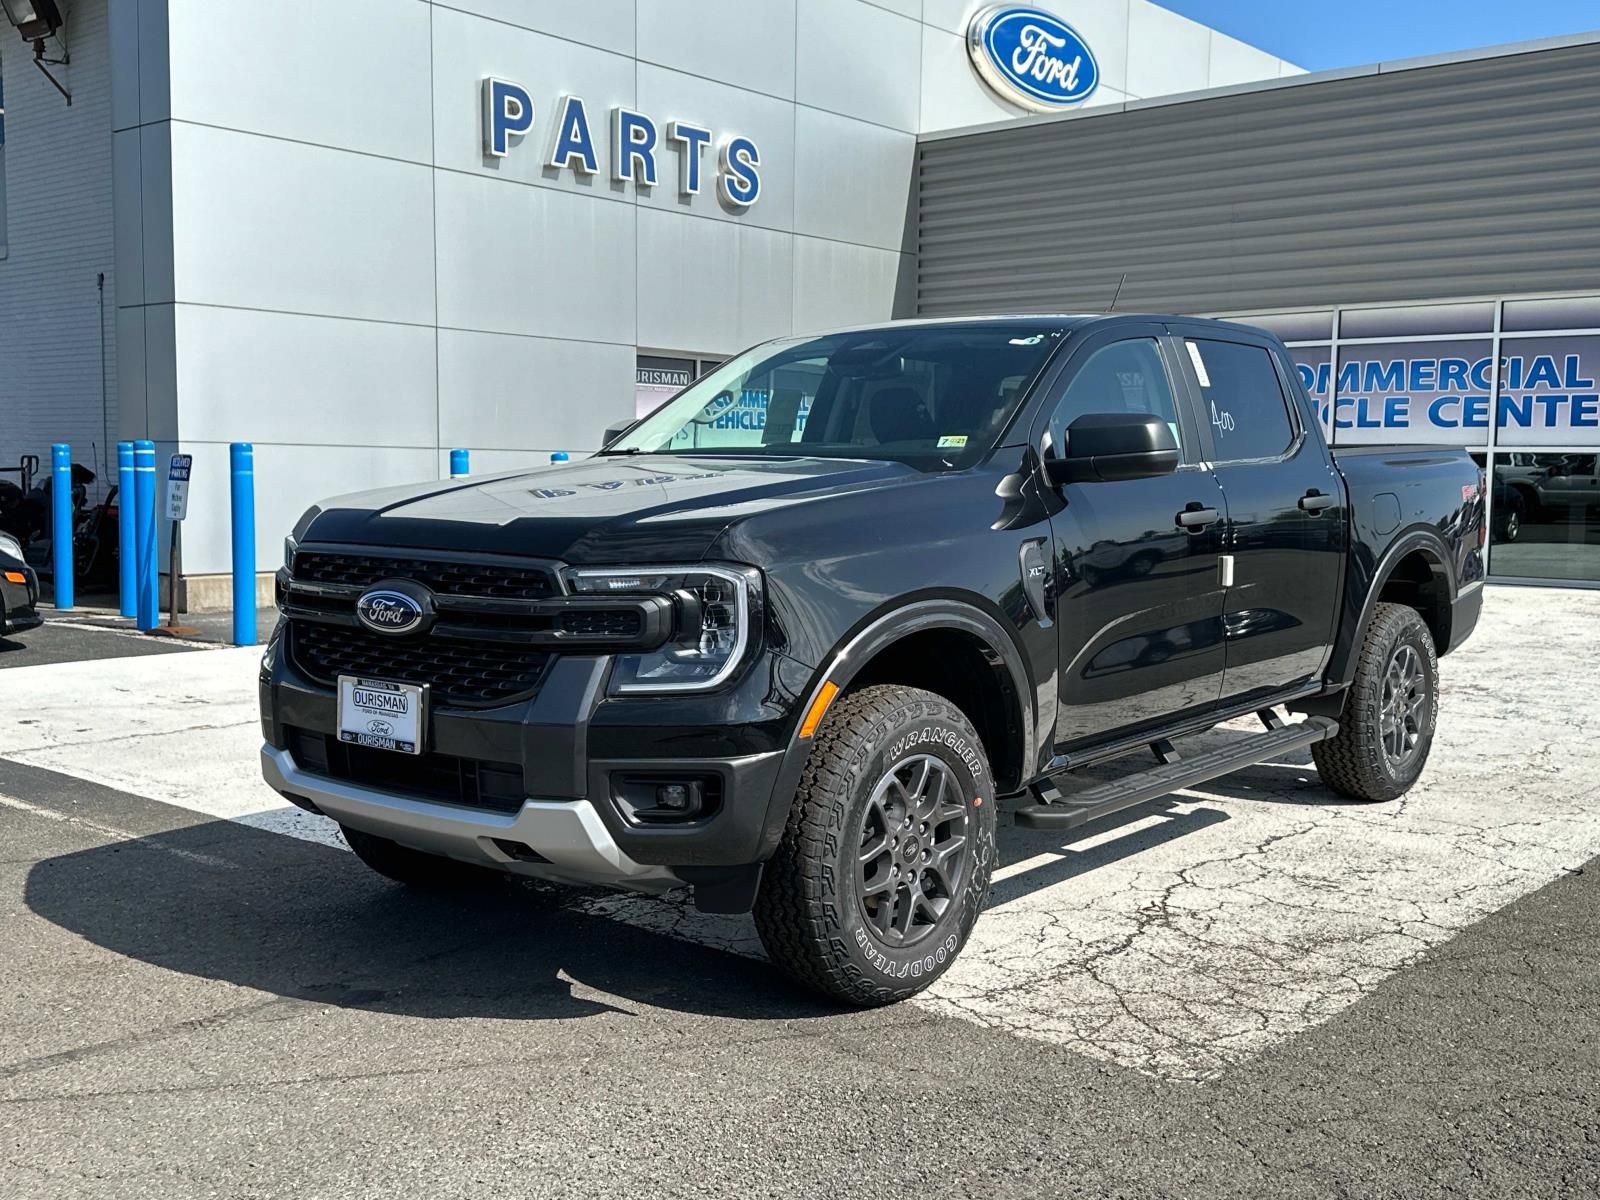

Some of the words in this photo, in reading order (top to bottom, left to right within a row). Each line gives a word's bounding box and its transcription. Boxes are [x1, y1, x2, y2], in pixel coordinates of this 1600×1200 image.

[1012, 24, 1081, 92] Ford
[484, 76, 761, 206] PARTS
[637, 370, 689, 385] RISMAN
[1295, 353, 1595, 395] OMMERCIAL
[1427, 392, 1600, 429] CENTE
[1029, 566, 1045, 578] XLT
[369, 598, 405, 623] Ford
[354, 690, 406, 712] OURISMAN
[358, 733, 396, 750] OURISMAN
[370, 721, 390, 735] Ford
[889, 727, 982, 777] WRANGLER
[855, 927, 958, 978] GOODYEAR
